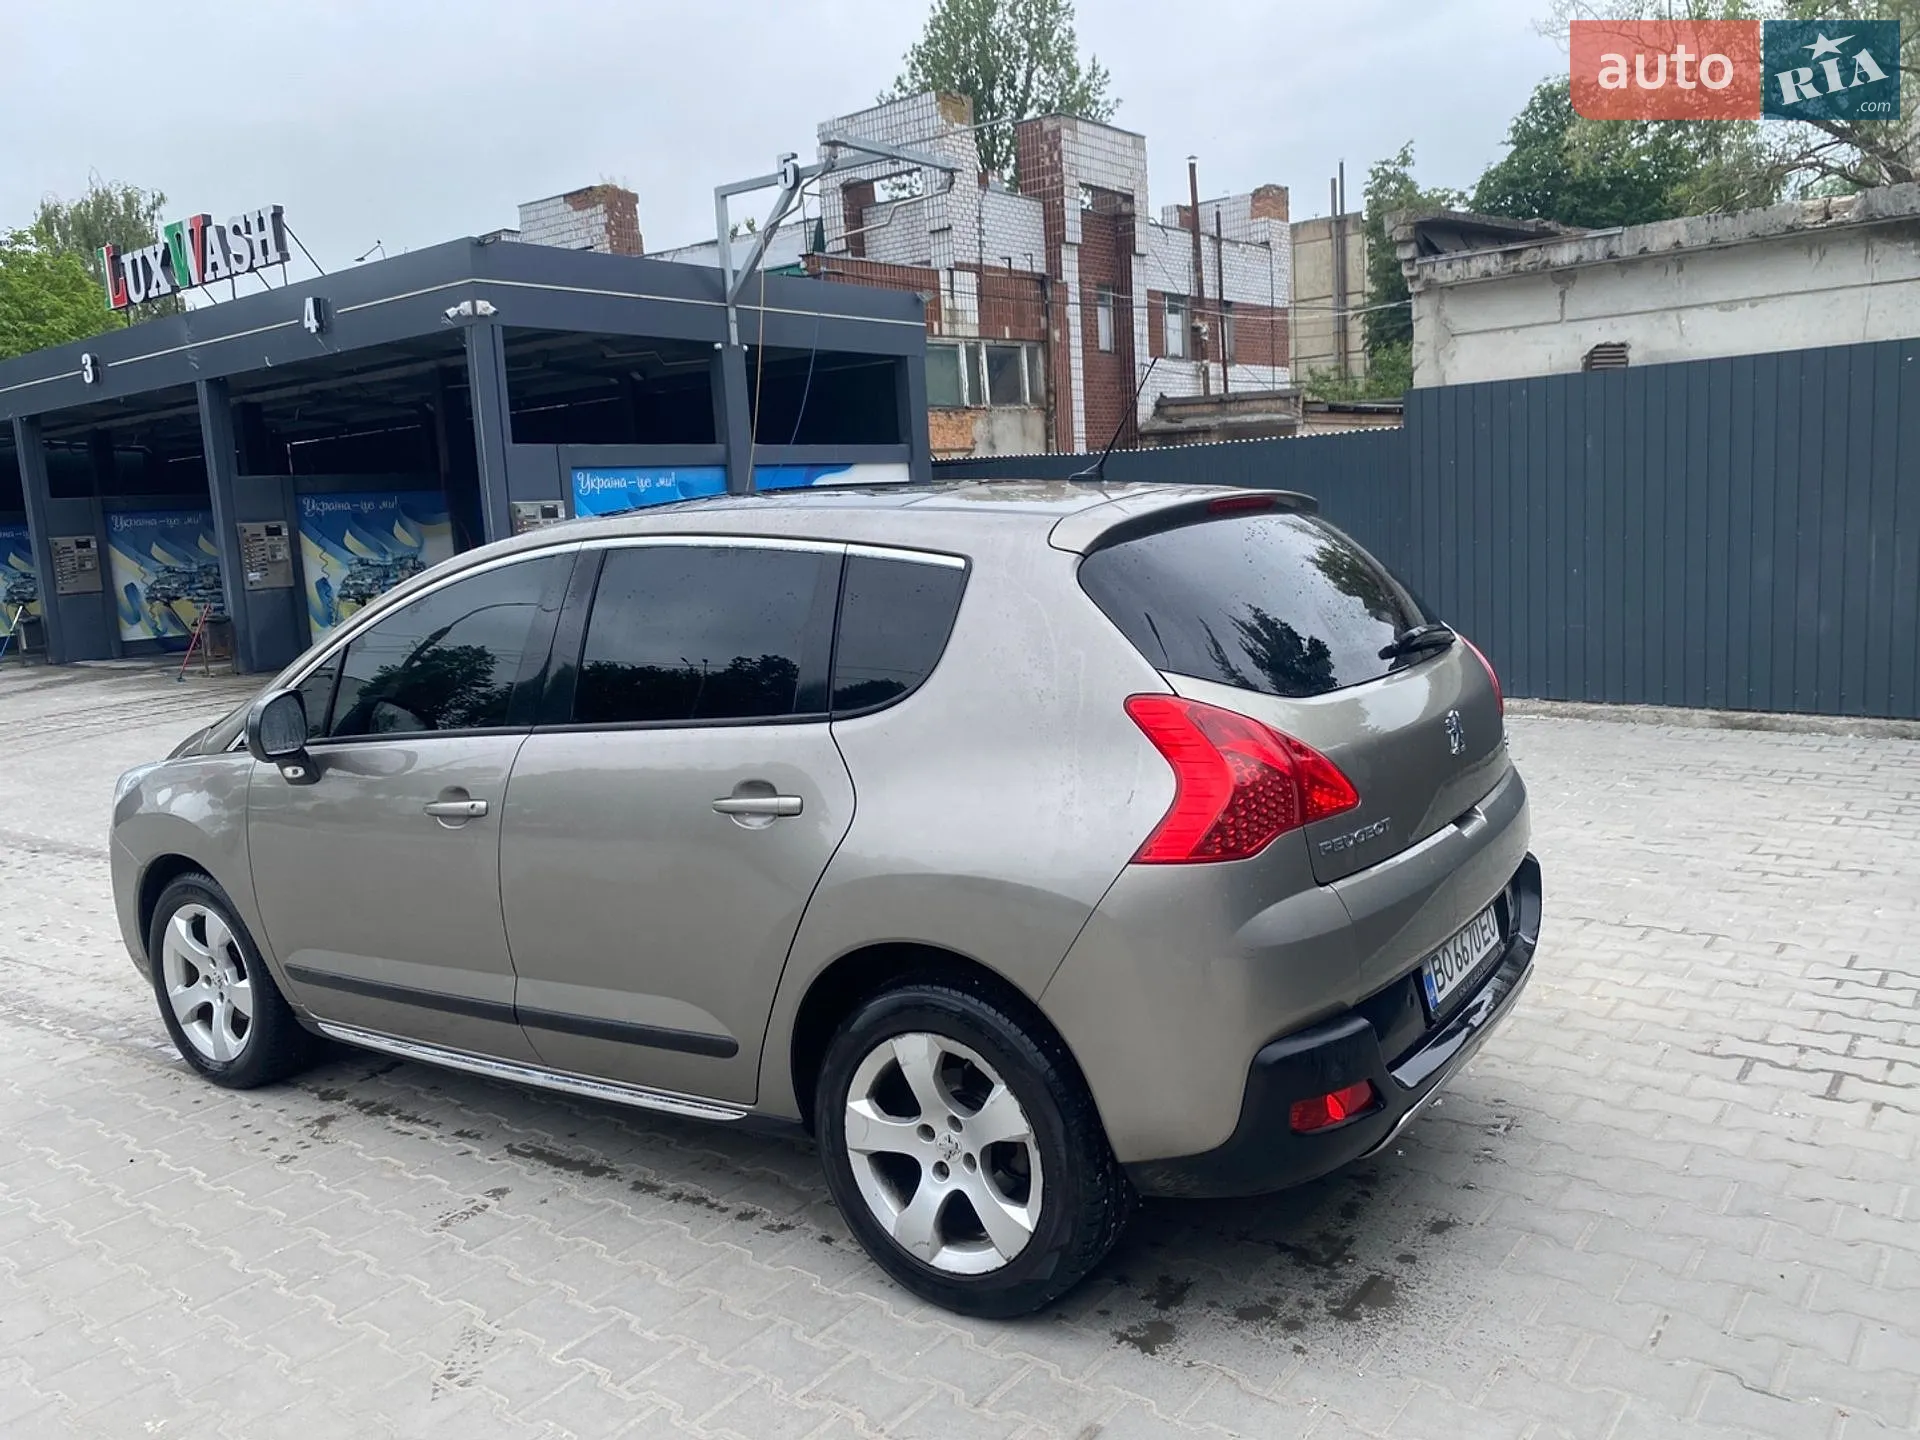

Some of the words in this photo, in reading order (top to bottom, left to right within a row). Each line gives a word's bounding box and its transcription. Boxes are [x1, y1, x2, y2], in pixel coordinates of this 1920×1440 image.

[777, 152, 797, 190] 5
[303, 297, 321, 333] 4
[81, 353, 97, 384] 3
[655, 471, 677, 488] ми!
[1318, 816, 1392, 856] PEUGEOT
